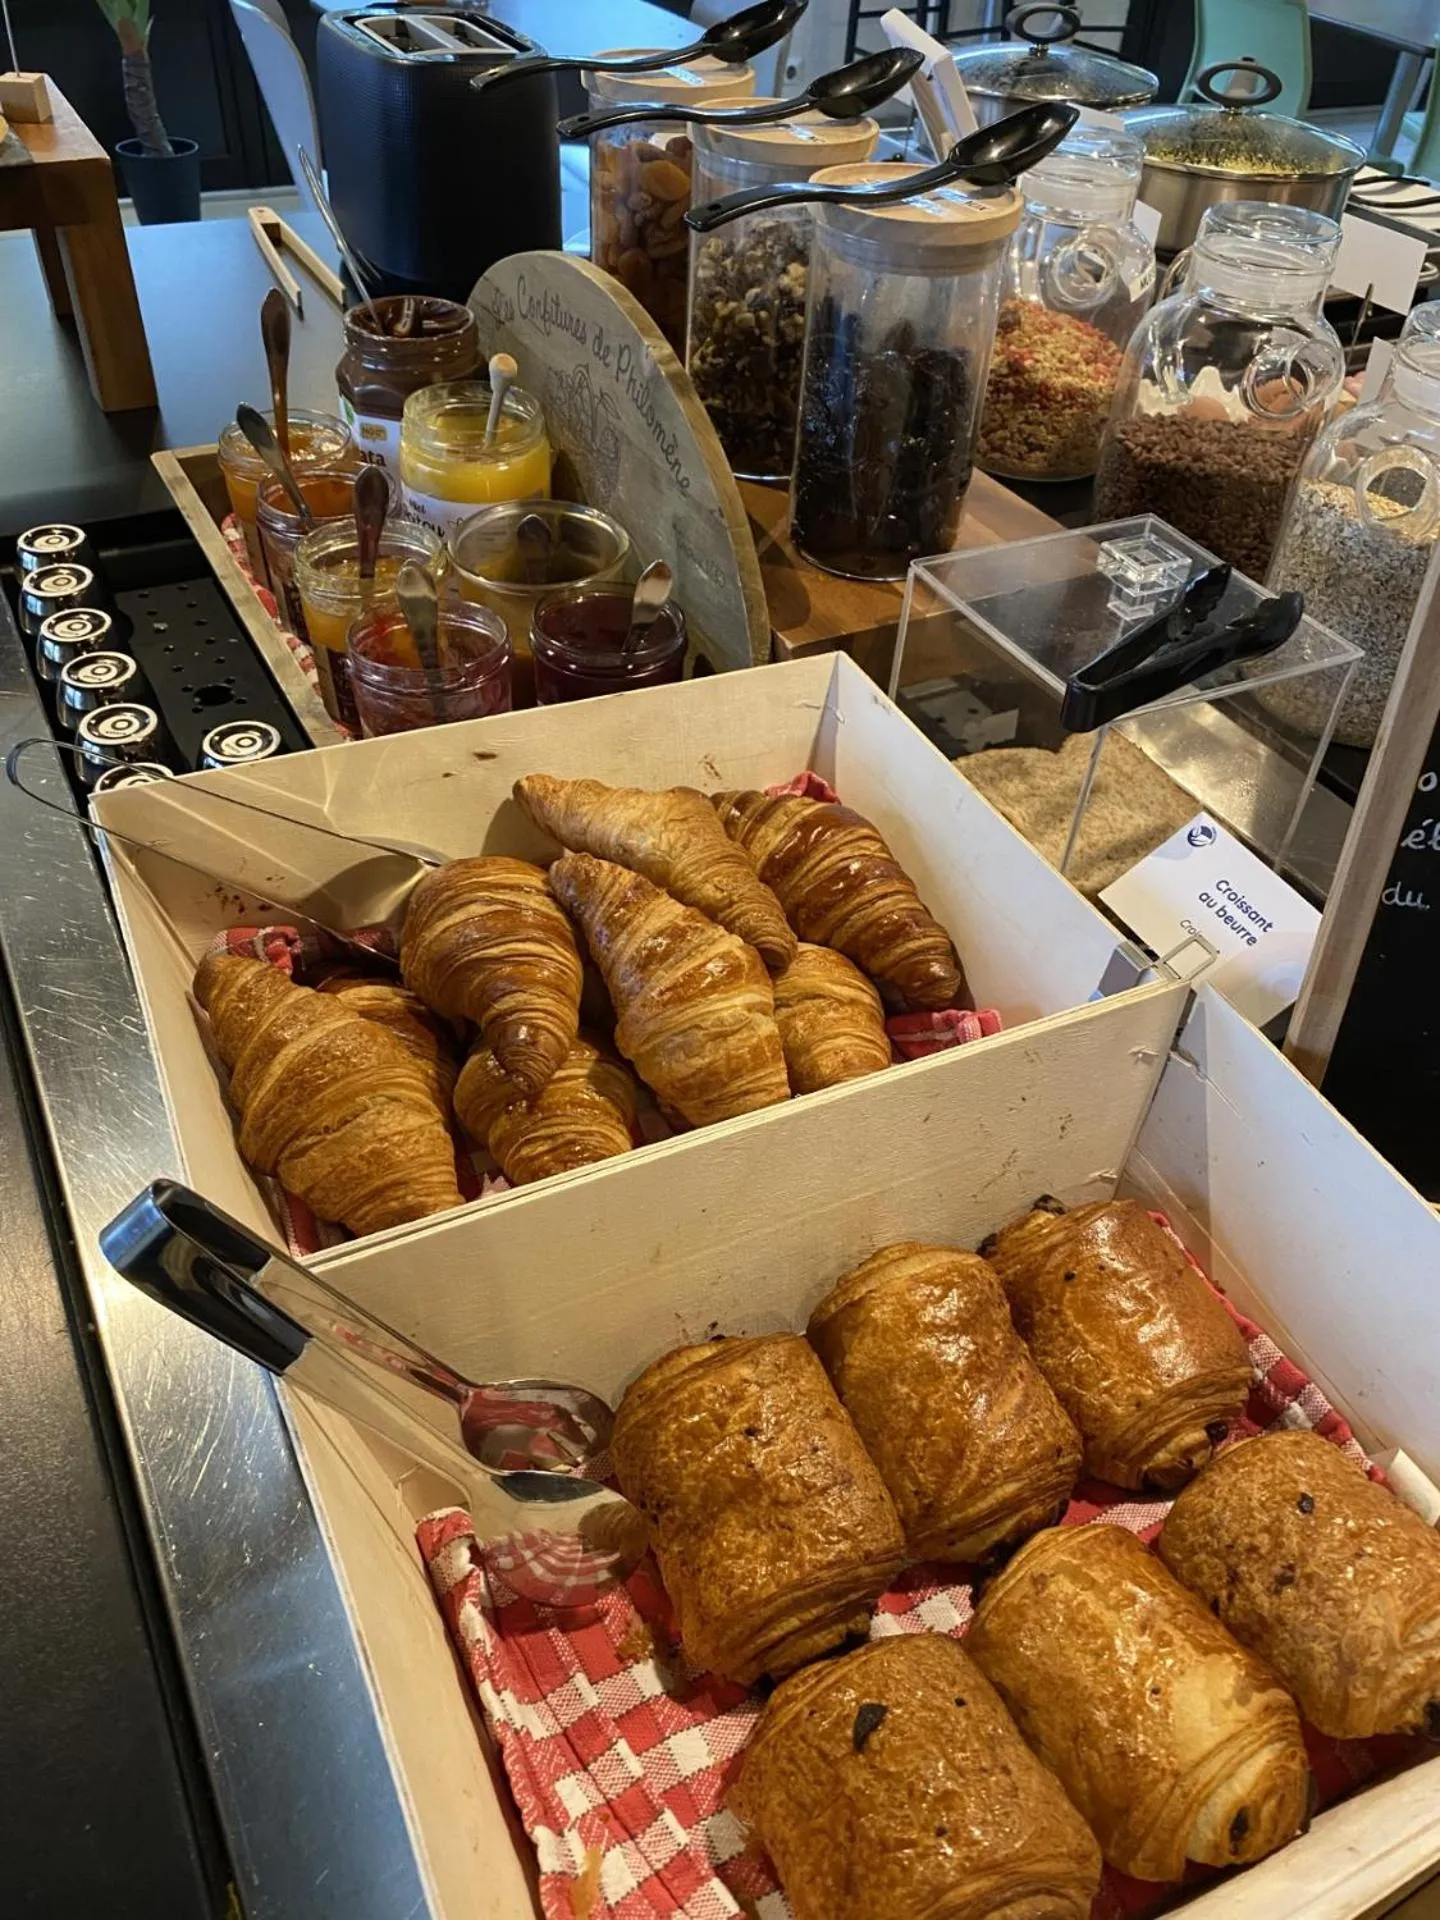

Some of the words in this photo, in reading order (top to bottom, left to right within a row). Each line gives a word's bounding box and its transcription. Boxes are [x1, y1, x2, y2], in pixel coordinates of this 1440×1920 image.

[517, 273, 588, 345] Confitures
[591, 325, 611, 367] de
[1198, 891, 1218, 909] au
[1214, 904, 1258, 946] beurre
[1215, 879, 1273, 933] Croissant
